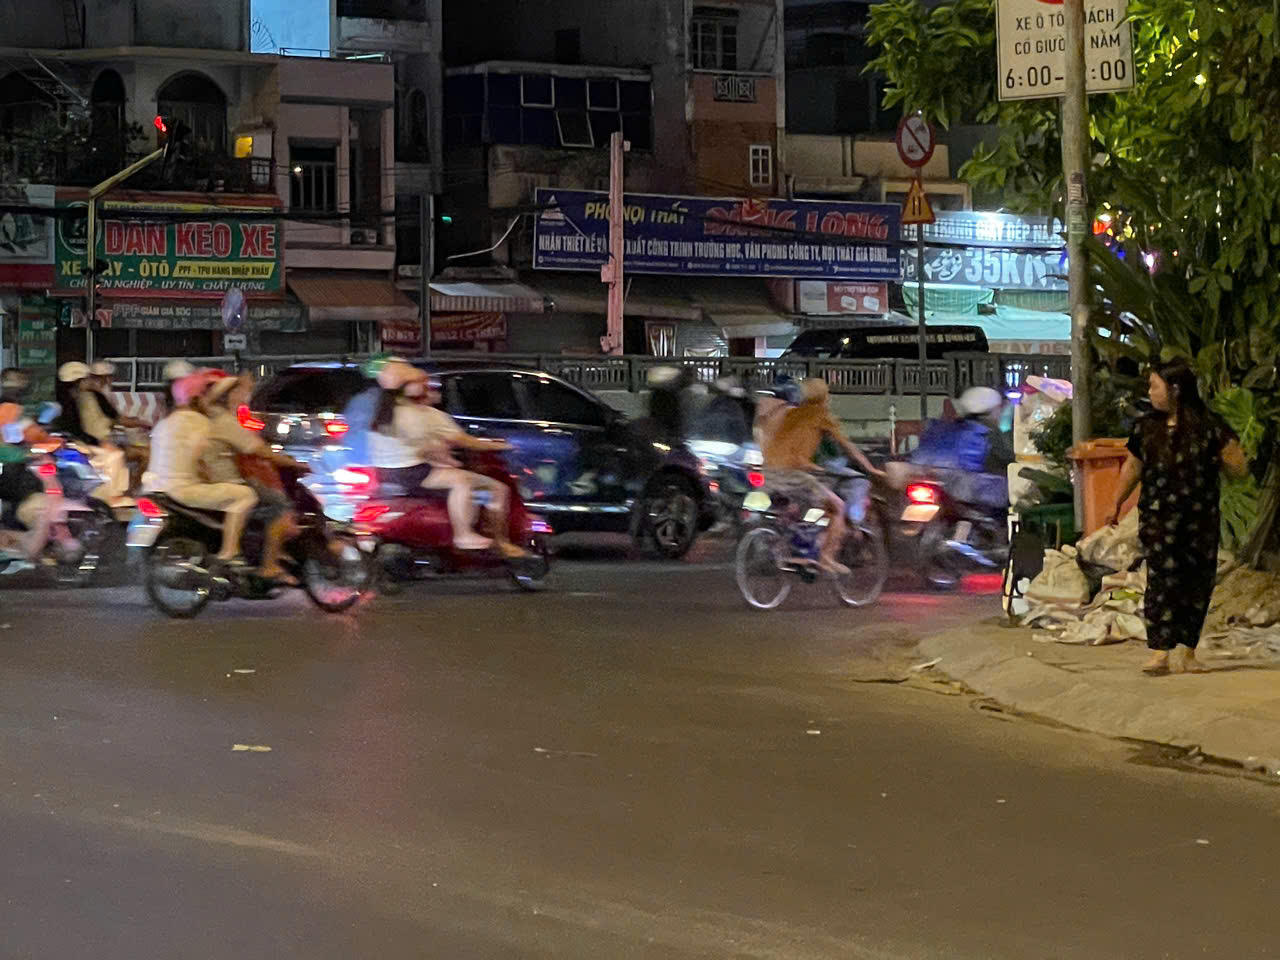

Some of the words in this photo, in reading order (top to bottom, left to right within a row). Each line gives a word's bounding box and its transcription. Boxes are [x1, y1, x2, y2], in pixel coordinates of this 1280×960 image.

[1015, 16, 1032, 31] XE
[1035, 12, 1044, 29] Ô
[1014, 37, 1031, 55] CÓ
[175, 221, 232, 257] KEO
[239, 222, 277, 258] XE
[647, 237, 669, 257] CÔNG
[788, 241, 810, 260] CÔNG
[61, 260, 81, 276] XE
[965, 247, 1021, 285] 35K
